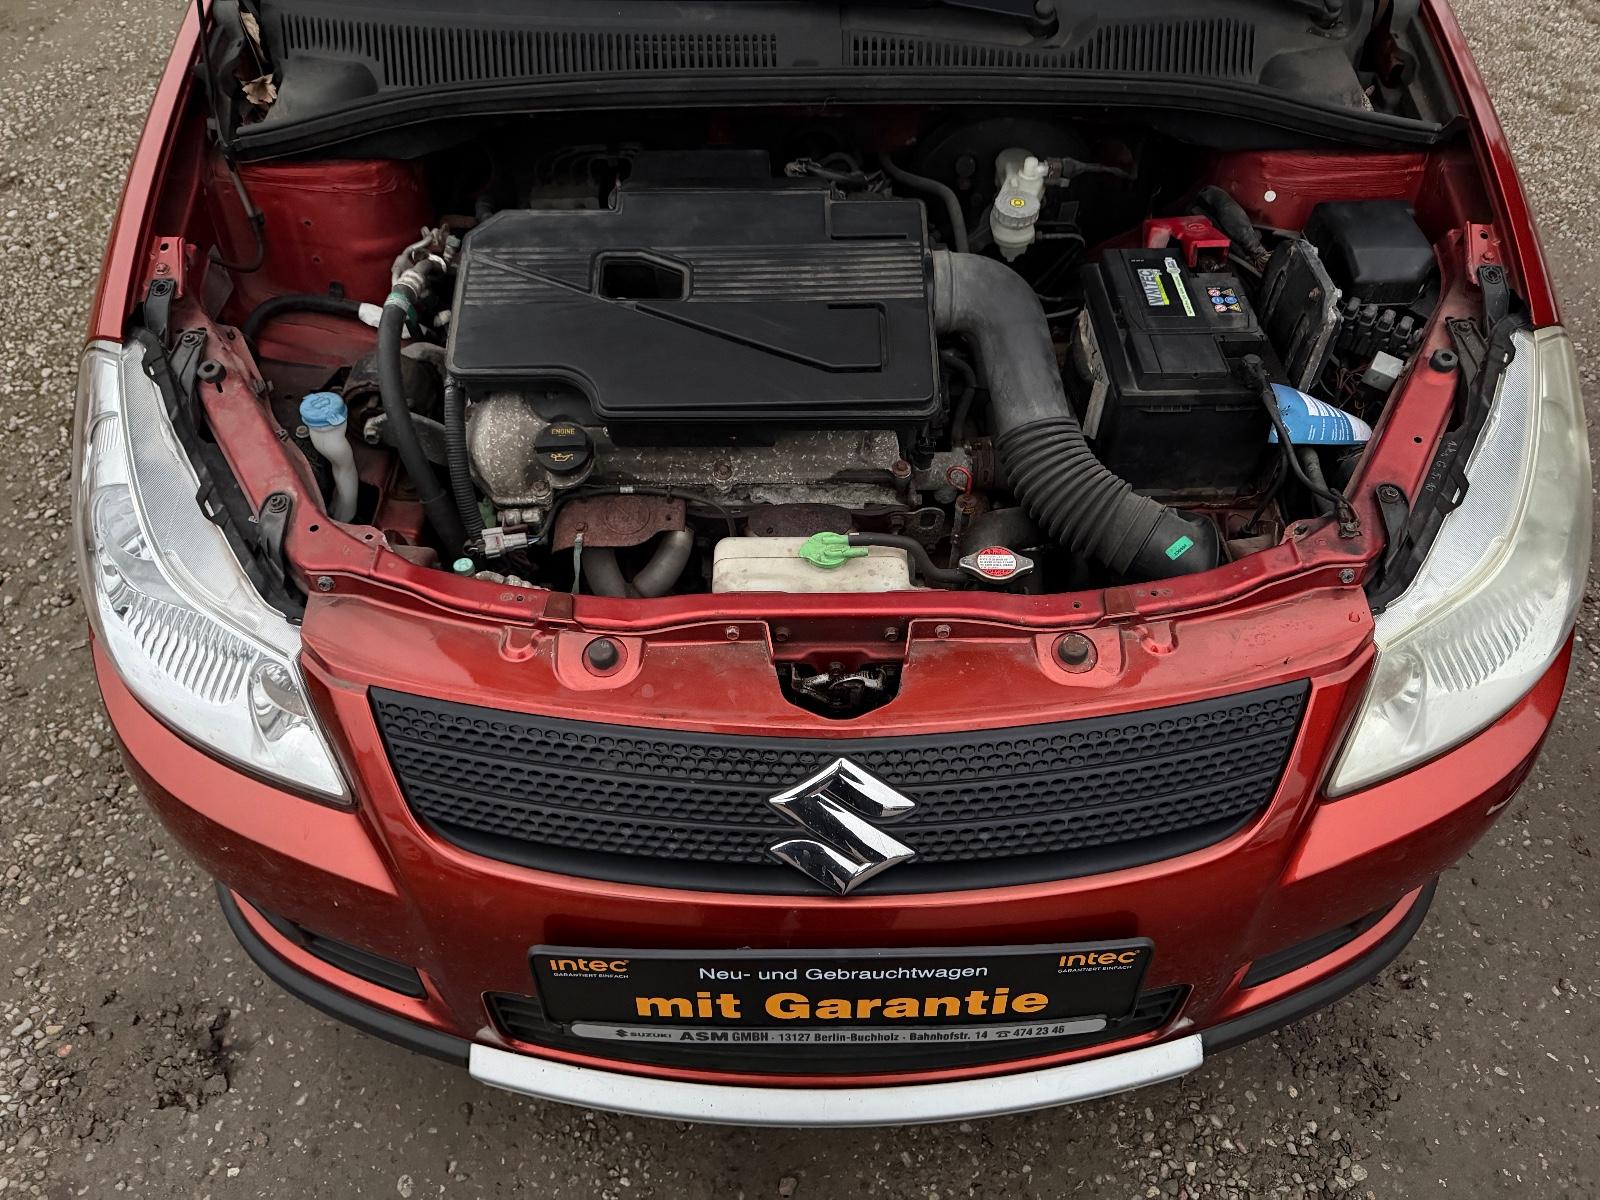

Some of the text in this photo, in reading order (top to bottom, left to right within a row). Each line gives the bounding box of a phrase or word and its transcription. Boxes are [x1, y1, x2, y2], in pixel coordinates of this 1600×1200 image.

[699, 966, 988, 980] Neu- und Gebrauchtwagen
[635, 987, 1049, 1020] mit Garantie
[630, 1031, 672, 1039] SUZUKI
[679, 1031, 729, 1042] ASM
[732, 1031, 769, 1042] GMBH
[778, 1033, 811, 1042] 13127
[814, 1032, 899, 1042] Berlin-Buchholz
[909, 1031, 970, 1041] Bahnhofstr.
[975, 1030, 987, 1039] 14
[1012, 1026, 1033, 1037] 474
[1035, 1026, 1049, 1036] 23
